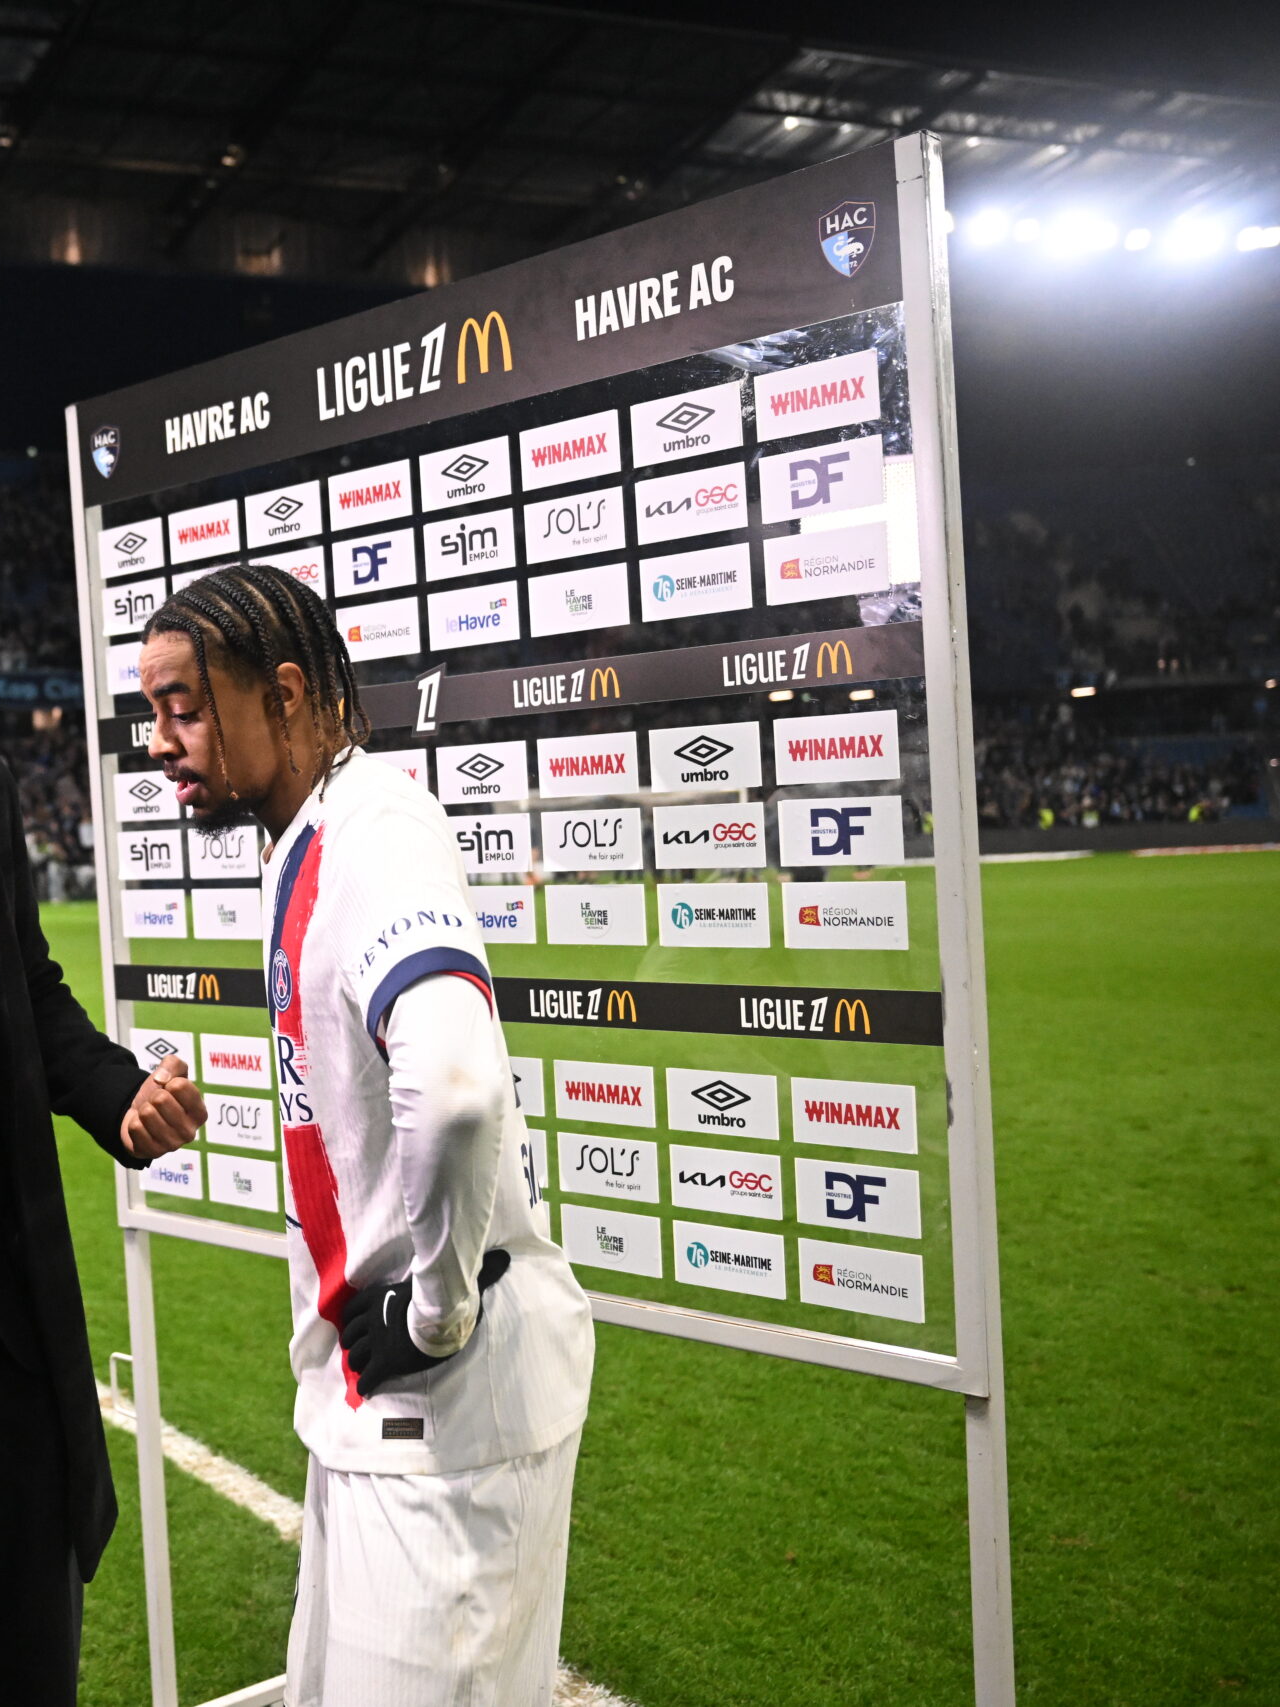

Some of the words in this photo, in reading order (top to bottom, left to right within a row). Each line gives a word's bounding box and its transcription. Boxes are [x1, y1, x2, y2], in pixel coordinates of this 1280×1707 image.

[826, 207, 867, 234] HAC
[574, 270, 681, 341] HAVRE
[689, 255, 735, 310] AC
[316, 342, 414, 421] LIGUE
[770, 376, 865, 417] WINAMAX
[165, 400, 236, 454] HAVRE
[239, 391, 270, 435] AC
[94, 431, 116, 448] HAC
[663, 433, 711, 453] umbro
[531, 432, 607, 468] WINAMAX
[446, 482, 486, 499] umbro
[789, 451, 850, 510] DF
[338, 480, 402, 510] WINAMAX
[695, 484, 738, 507] GSC
[543, 499, 607, 538] SOL'S
[177, 518, 231, 544] WINAMAX
[268, 521, 301, 537] umbro
[440, 523, 498, 566] sim
[117, 556, 145, 568] umbro
[351, 541, 392, 585] DF
[469, 549, 498, 562] EMPLOI
[804, 558, 875, 577] NORMANDIE
[676, 570, 737, 590] SEINE-MARITIME
[114, 590, 154, 624] sim
[566, 594, 593, 605] HAVRE
[569, 602, 593, 612] SEINE
[363, 627, 410, 641] NORMANDIE
[722, 650, 788, 687] LIGUE
[513, 674, 567, 709] LIGUE
[788, 734, 884, 762] WINAMAX
[549, 753, 626, 778] WINAMAX
[681, 768, 729, 783] umbro
[462, 782, 501, 796] umbro
[132, 804, 160, 814] umbro
[559, 818, 623, 848] SOL'S
[712, 822, 757, 841] GSC
[810, 807, 872, 856] DF
[456, 821, 513, 864] sim
[130, 837, 170, 871] sim
[485, 852, 515, 862] EMPLOI
[609, 853, 624, 861] spirit
[581, 902, 590, 910] LE
[581, 910, 608, 918] HAVRE
[694, 907, 756, 921] SEINE-MARITIME
[822, 905, 858, 916] RÉGION
[476, 912, 517, 928] Havre
[584, 916, 608, 926] SEINE
[823, 916, 894, 927] NORMANDIE
[359, 910, 463, 978] EYOND
[147, 973, 184, 999] LIGUE
[529, 988, 583, 1020] LIGUE
[739, 997, 806, 1031] LIGUE
[209, 1052, 262, 1072] WINAMAX
[565, 1080, 642, 1107] WINAMAX
[698, 1112, 746, 1128] umbro
[804, 1100, 901, 1130] WINAMAX
[576, 1144, 639, 1177] SOL'S
[605, 1179, 614, 1188] the
[615, 1181, 625, 1189] fair
[626, 1183, 641, 1191] spirit
[729, 1170, 773, 1193] GSC
[730, 1189, 748, 1197] groupe
[762, 1192, 773, 1200] clair
[824, 1171, 886, 1222] DF
[825, 1191, 852, 1200] INDUSTRIE
[596, 1225, 606, 1235] LE
[597, 1233, 624, 1245] HAVRE
[600, 1242, 624, 1253] SEINE
[710, 1250, 772, 1271] SEINE-MARITIME
[837, 1268, 872, 1281] RÉGION
[837, 1277, 909, 1298] NORMANDIE
